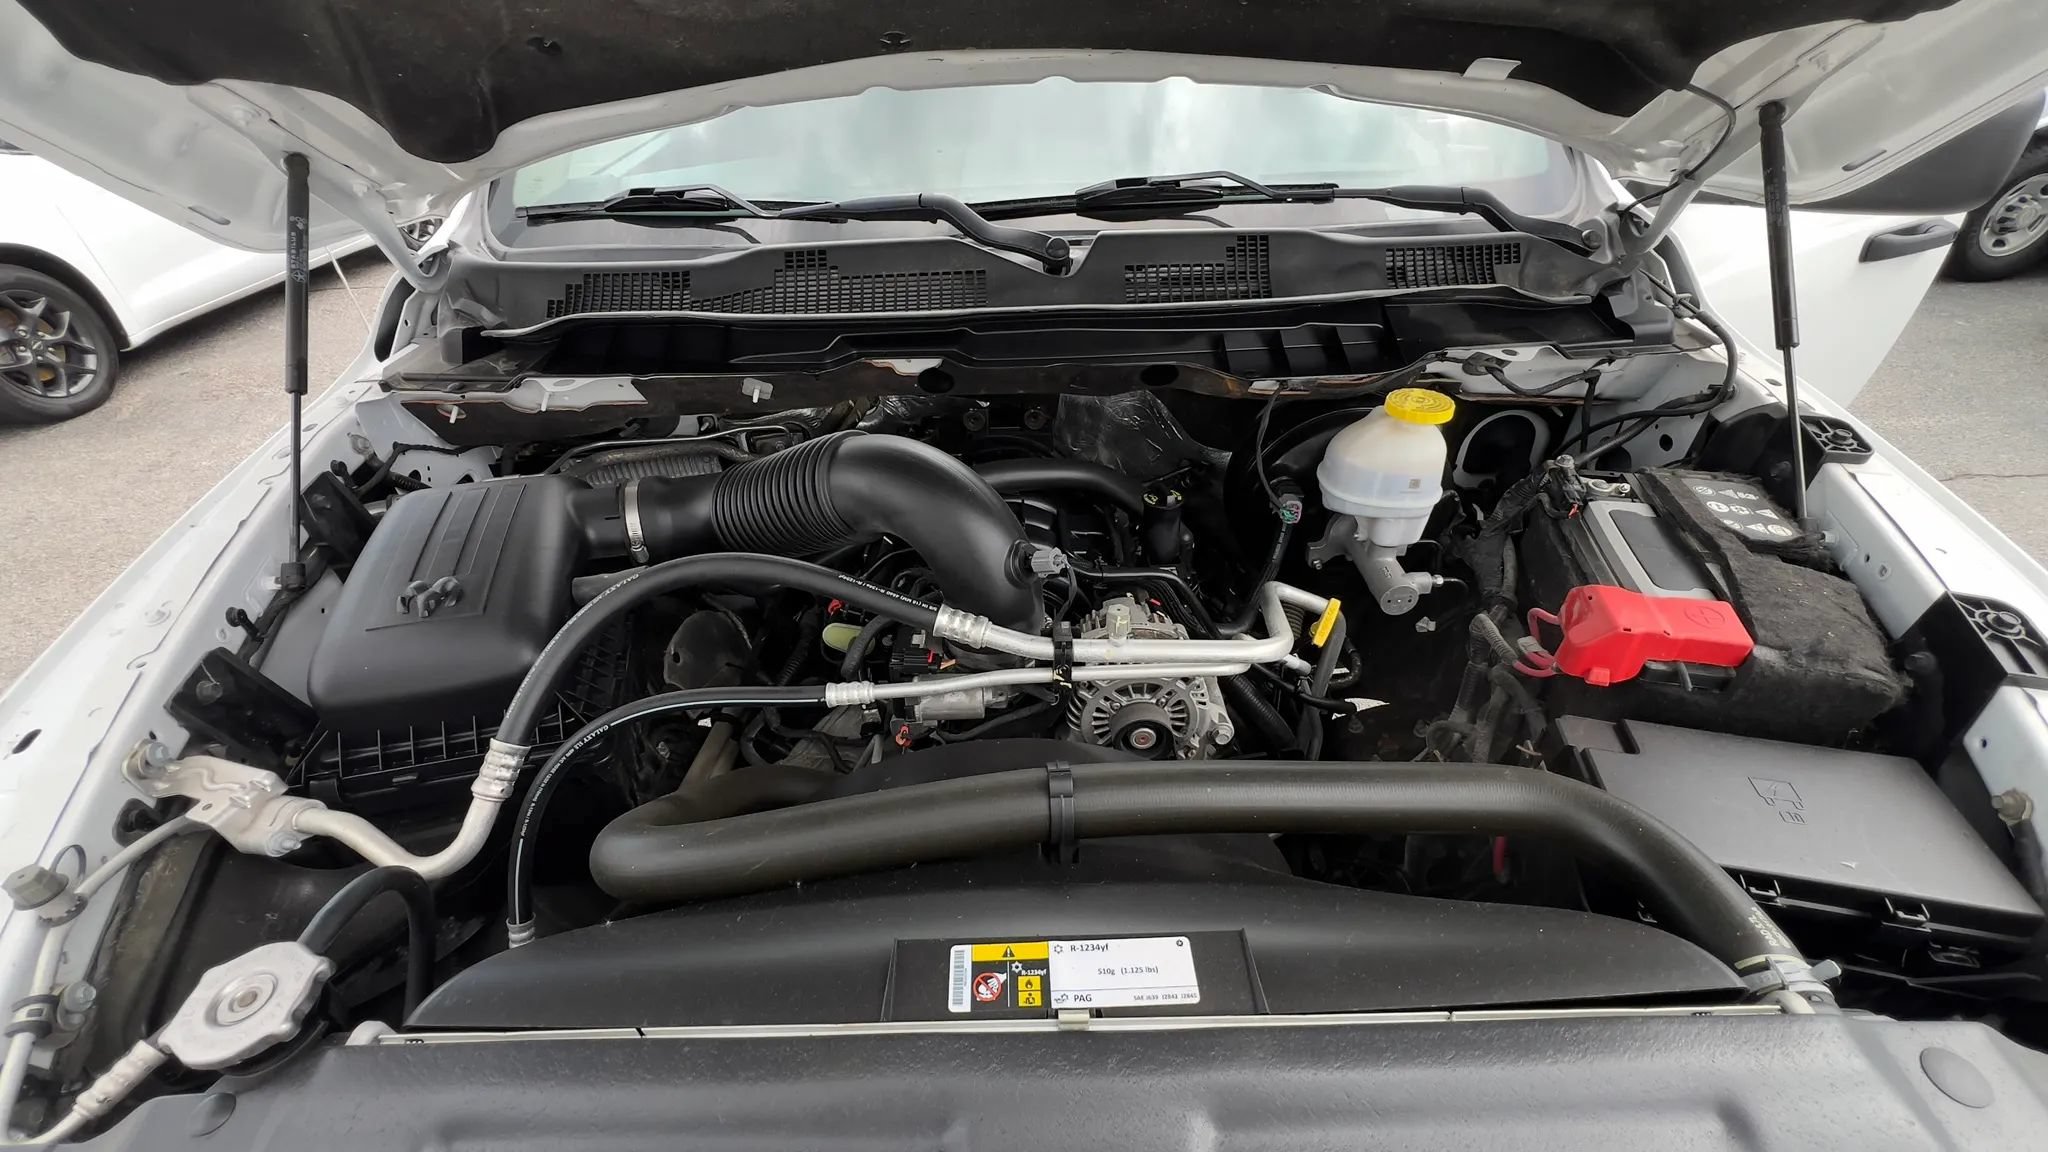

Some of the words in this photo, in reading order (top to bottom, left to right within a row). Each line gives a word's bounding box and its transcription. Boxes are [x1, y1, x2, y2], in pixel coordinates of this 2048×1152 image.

[1070, 943, 1109, 953] R-1234yf
[1145, 965, 1159, 974] lbs)
[1074, 993, 1093, 1003] PAG
